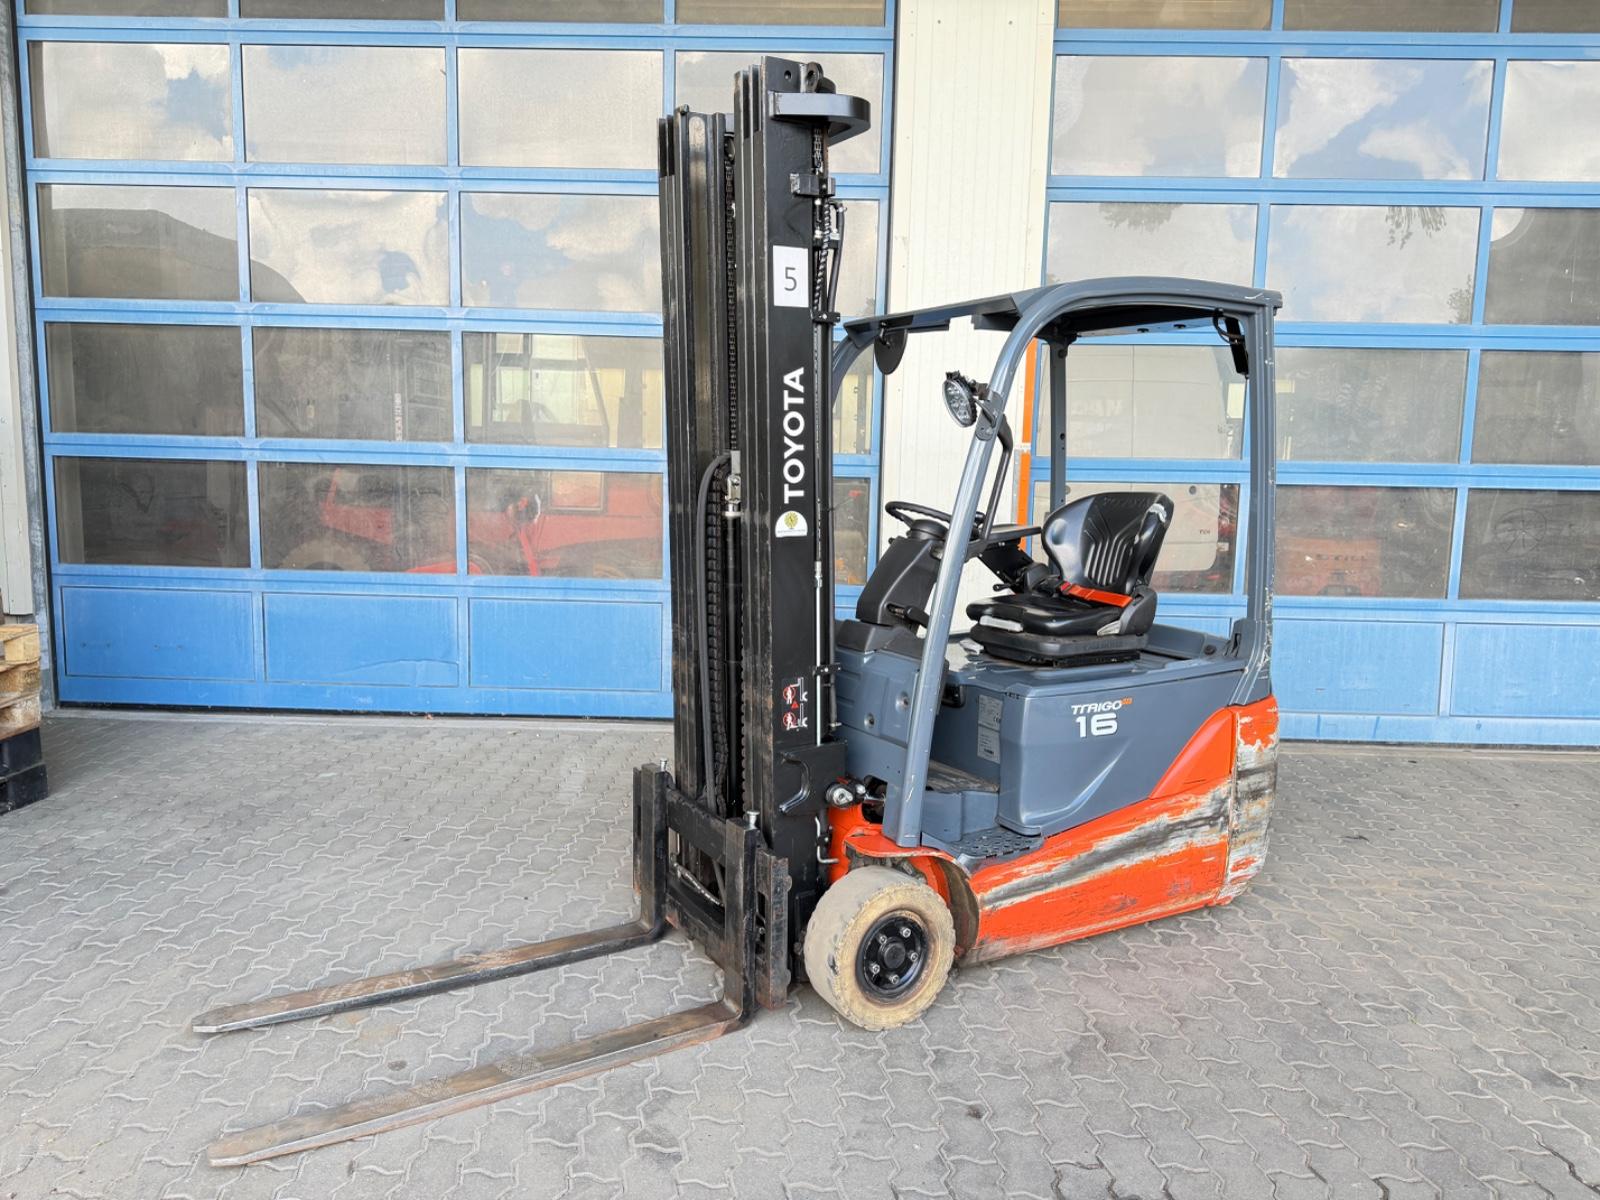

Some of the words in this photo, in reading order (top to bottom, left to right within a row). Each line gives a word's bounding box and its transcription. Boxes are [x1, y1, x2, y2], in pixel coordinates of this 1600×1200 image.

[784, 266, 798, 292] 5
[783, 366, 805, 504] TOYOTA
[1075, 712, 1118, 738] 16
